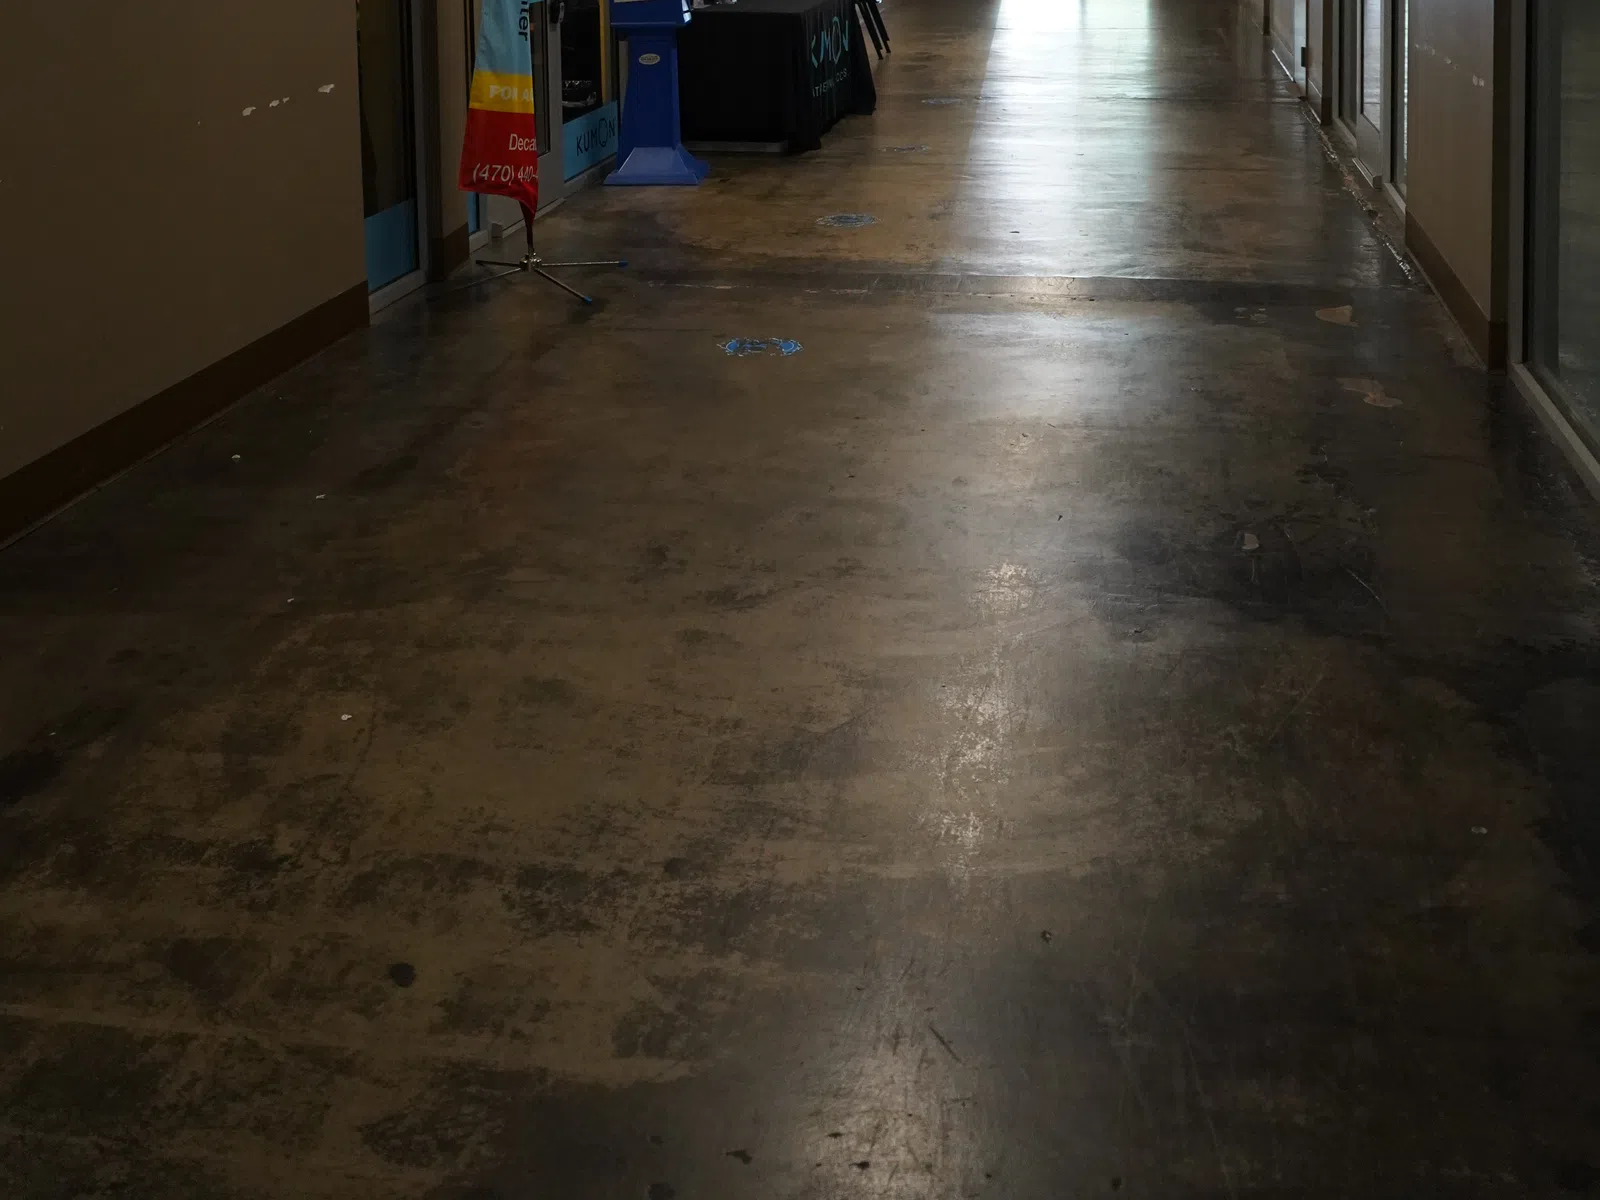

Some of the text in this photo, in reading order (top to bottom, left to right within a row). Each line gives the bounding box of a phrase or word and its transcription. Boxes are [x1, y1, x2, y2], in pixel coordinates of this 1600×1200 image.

[508, 133, 537, 151] Deca
[576, 117, 615, 157] KUMON
[473, 163, 538, 186] (470) 440-
